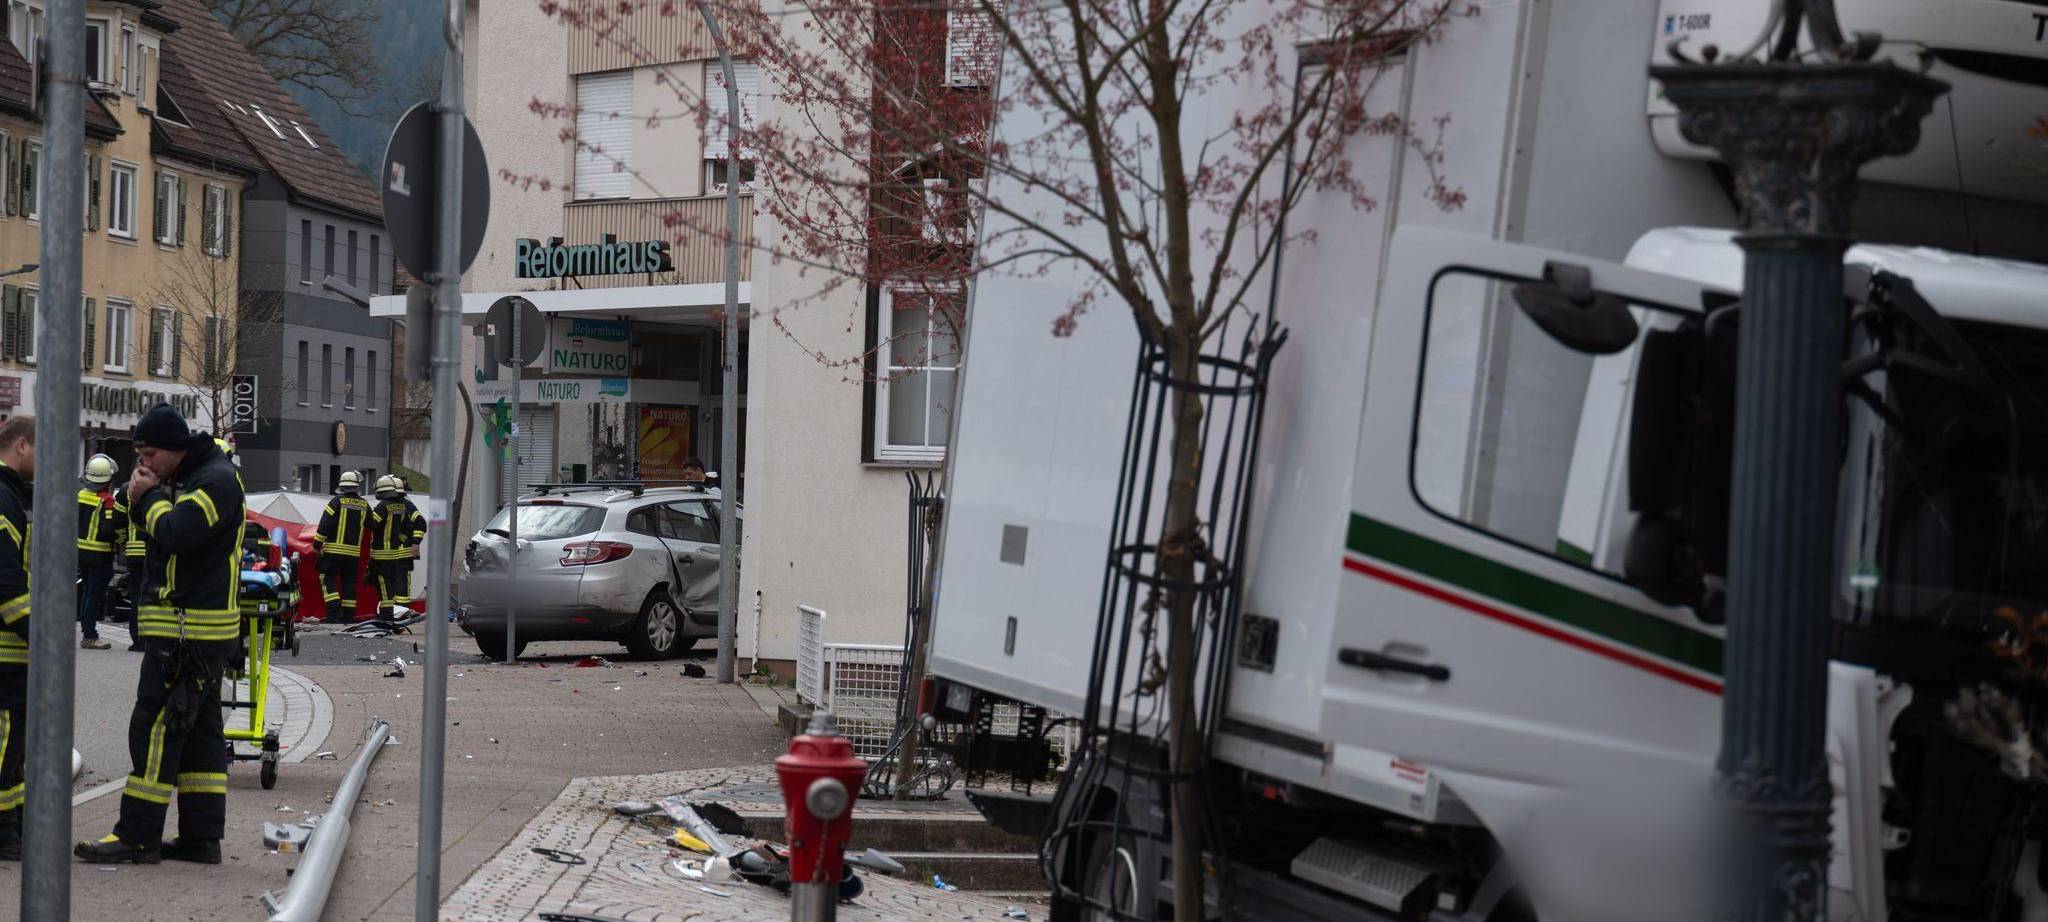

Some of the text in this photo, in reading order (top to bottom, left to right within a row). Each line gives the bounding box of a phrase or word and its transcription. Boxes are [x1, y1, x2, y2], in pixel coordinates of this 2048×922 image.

[1679, 13, 1711, 31] T-600R
[515, 234, 672, 278] Reformhaus
[574, 321, 625, 338] Reformhaus
[554, 349, 627, 371] NATURO
[537, 380, 581, 401] NATURO
[171, 393, 201, 419] HOF
[650, 409, 688, 421] NATURO
